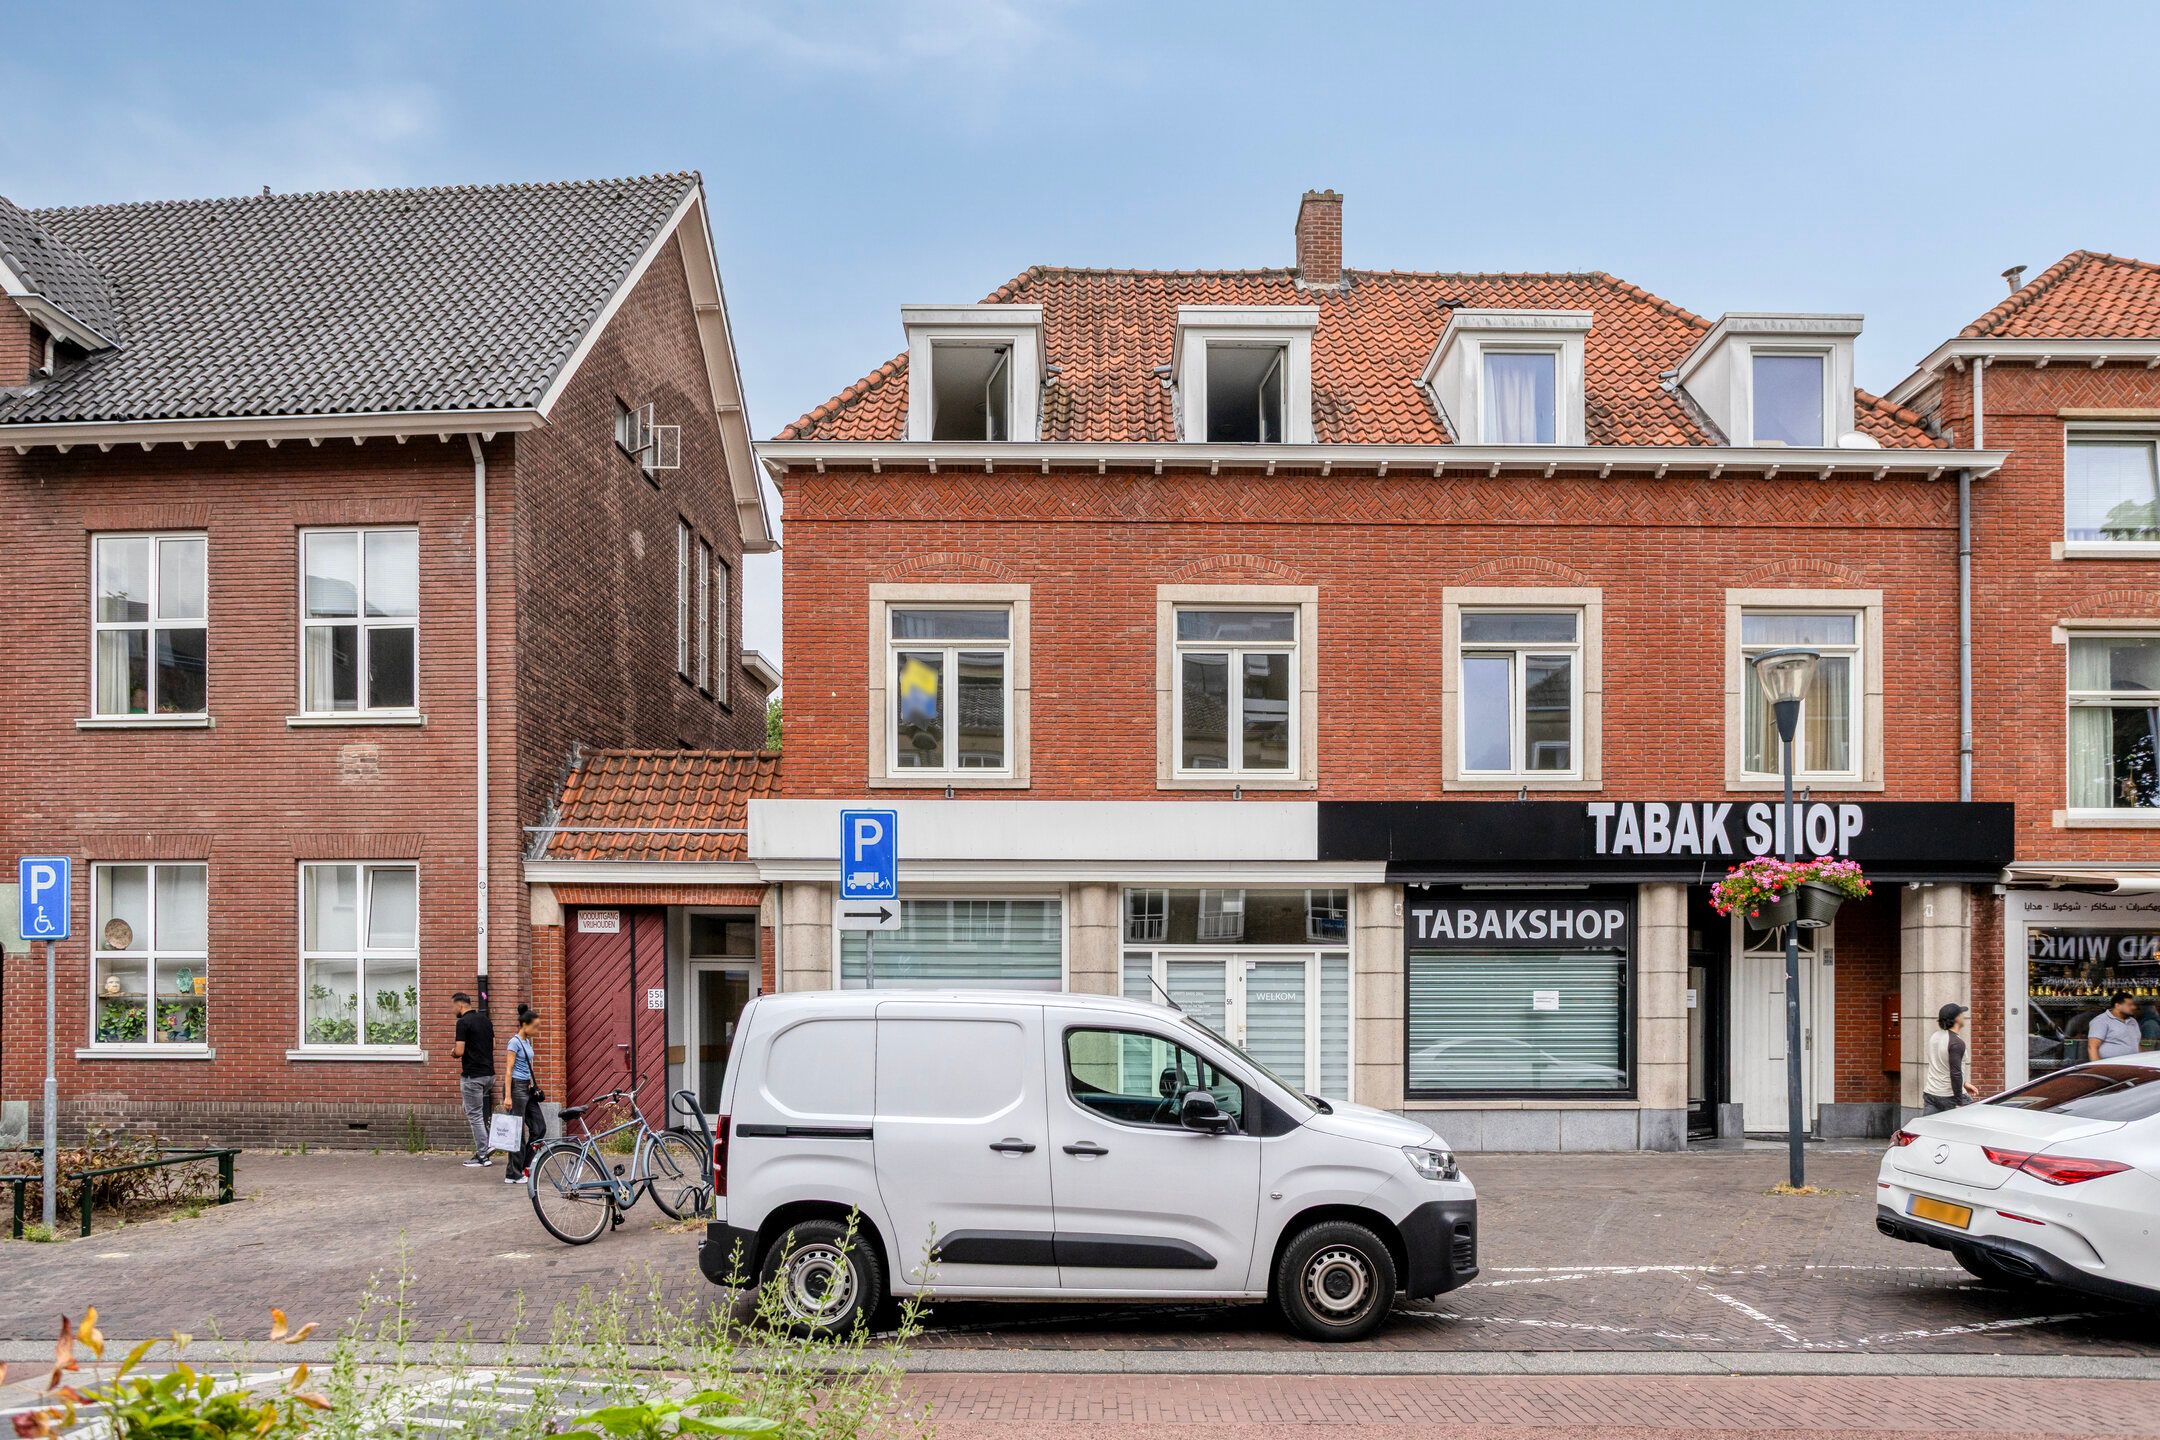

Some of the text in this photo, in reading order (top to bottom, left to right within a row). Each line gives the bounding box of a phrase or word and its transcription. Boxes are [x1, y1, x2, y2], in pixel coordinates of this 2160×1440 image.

[1588, 802, 1863, 856] TABAK SHOP
[854, 818, 883, 862] P
[31, 865, 57, 905] P
[579, 912, 619, 920] NOODUITGANG
[2024, 902, 2042, 912] هدايا
[583, 920, 615, 928] VRIJHOUDEN
[1411, 909, 1625, 940] TABAKSHOP
[1256, 992, 1296, 1001] WELKOM
